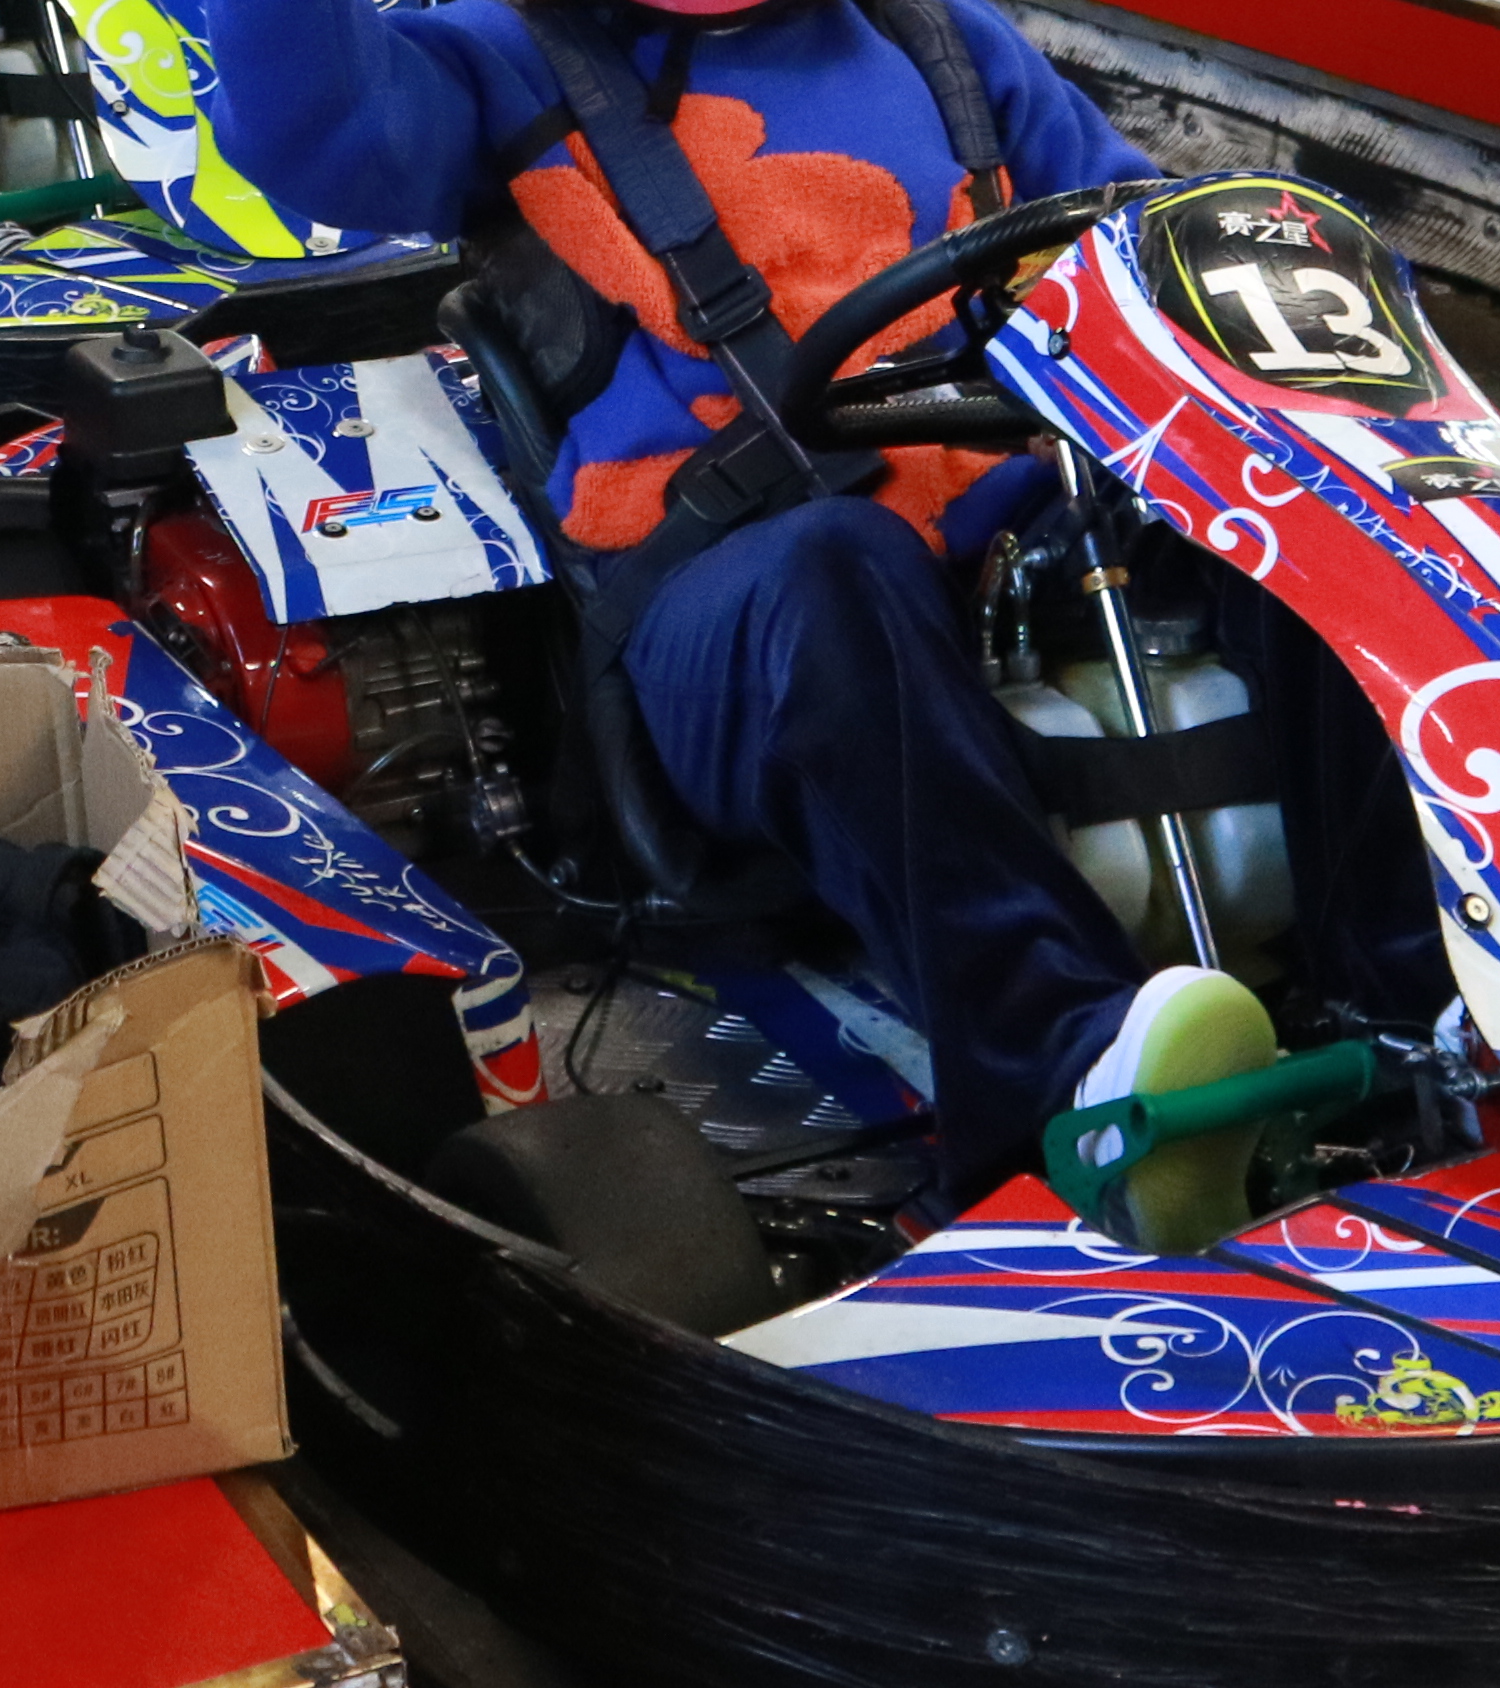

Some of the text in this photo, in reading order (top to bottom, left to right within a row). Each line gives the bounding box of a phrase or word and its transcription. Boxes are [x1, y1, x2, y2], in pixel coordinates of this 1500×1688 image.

[1200, 260, 1413, 379] 13
[64, 1170, 94, 1190] XL
[106, 1240, 149, 1274] 粉红
